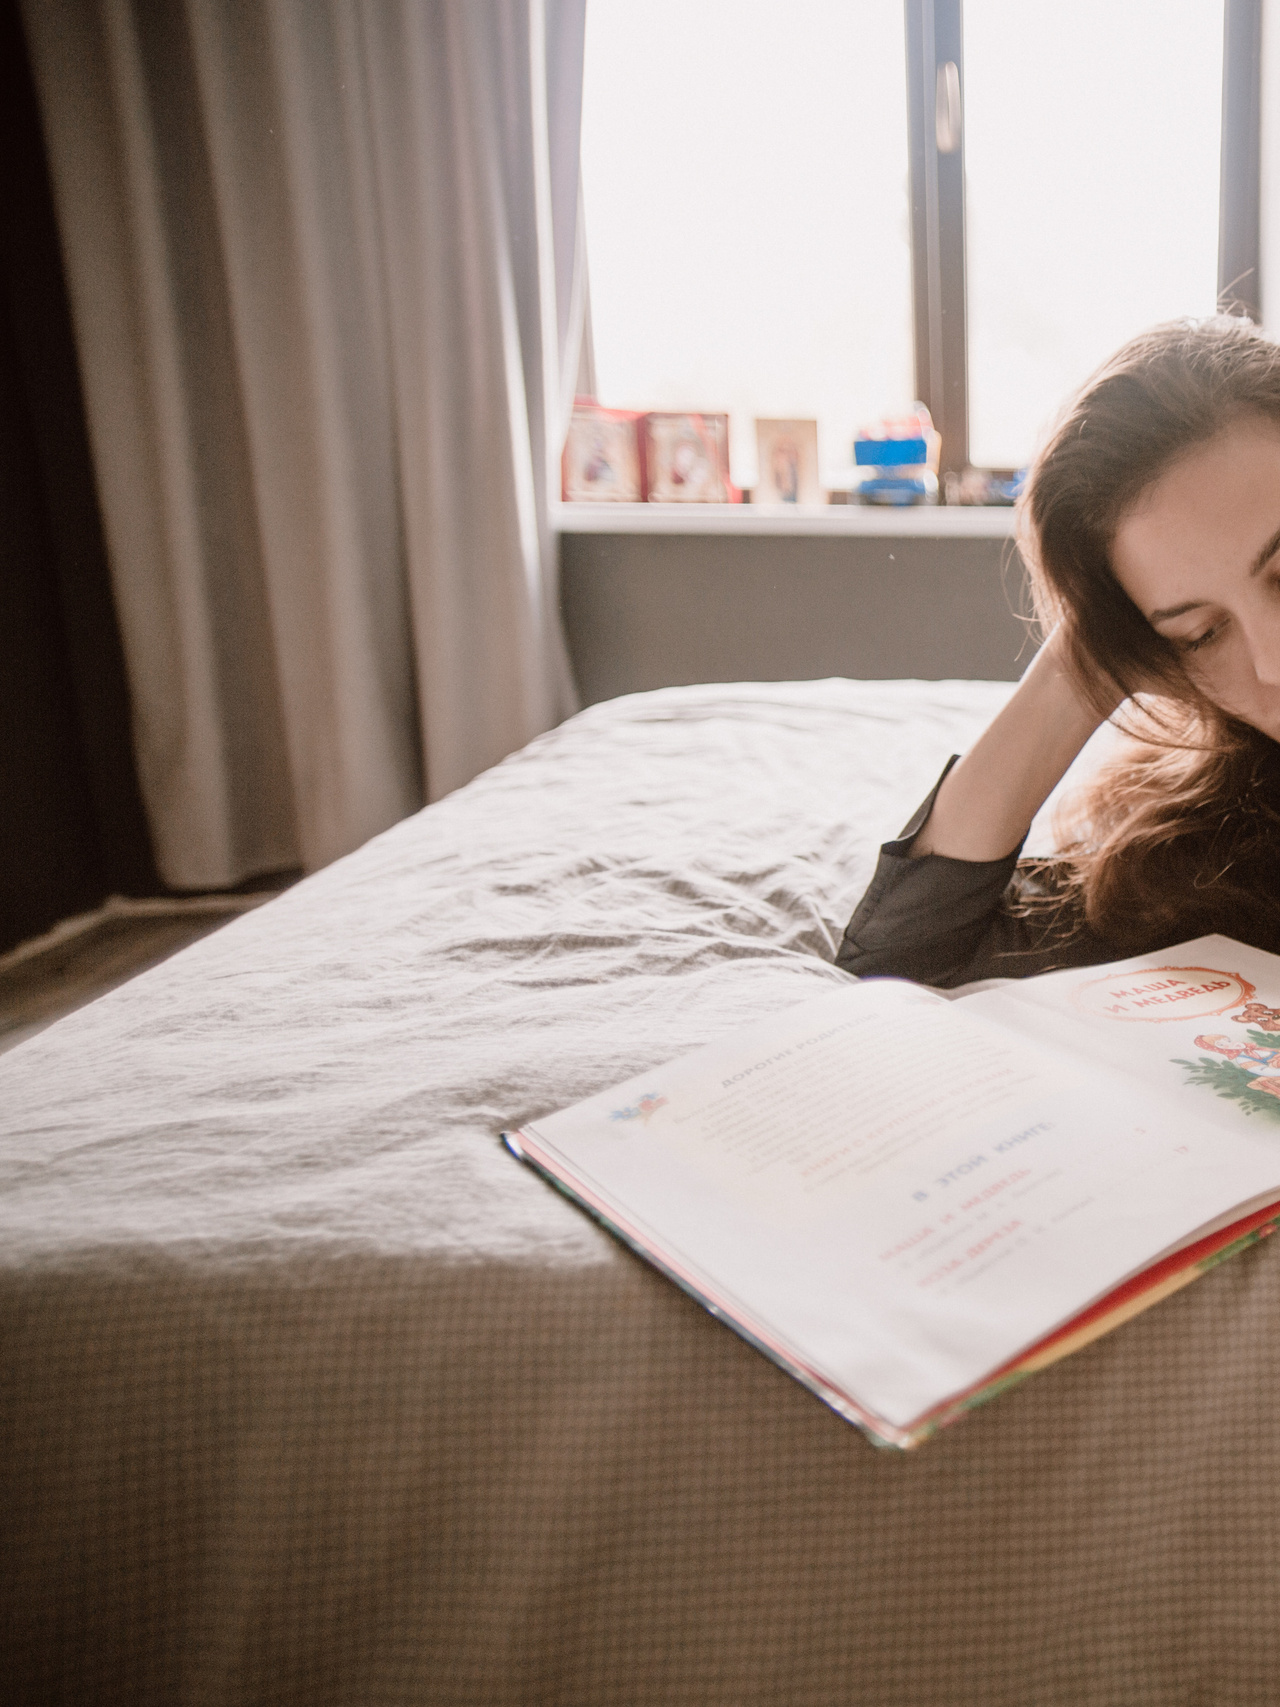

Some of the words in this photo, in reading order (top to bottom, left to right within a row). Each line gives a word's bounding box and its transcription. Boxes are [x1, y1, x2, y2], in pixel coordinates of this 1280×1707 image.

[1102, 1004, 1130, 1014] И
[1132, 980, 1231, 1008] МЕДВЕДЬ
[1109, 977, 1187, 998] МАША
[721, 1048, 794, 1089] ДОРОГИЕ
